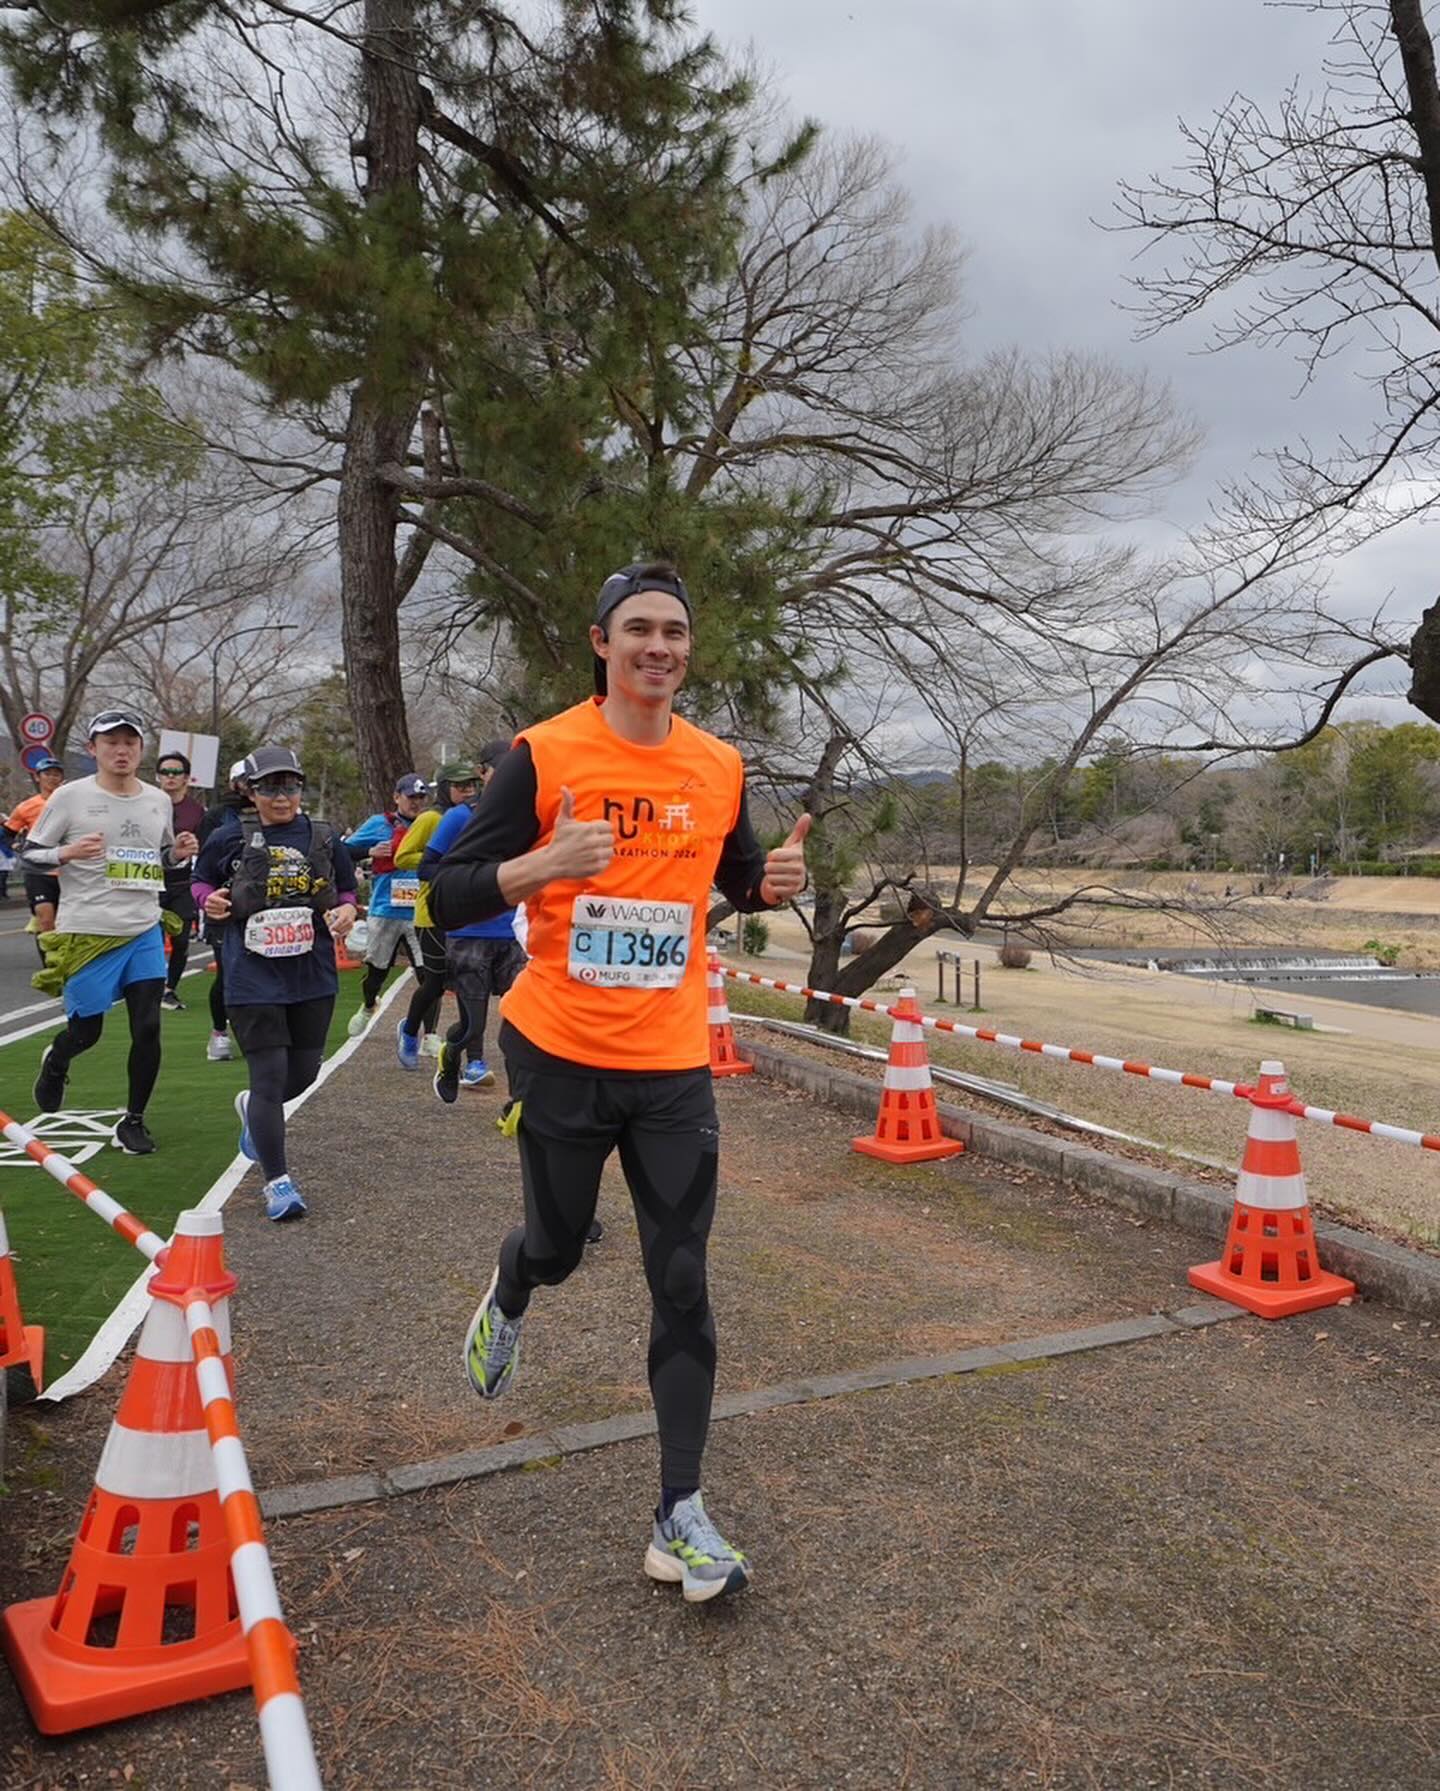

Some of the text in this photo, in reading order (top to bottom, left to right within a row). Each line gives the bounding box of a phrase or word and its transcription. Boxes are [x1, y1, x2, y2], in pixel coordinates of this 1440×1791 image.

[28, 721, 46, 733] 40
[603, 797, 654, 839] run
[612, 847, 669, 858] ARATHON
[611, 905, 684, 924] WACOAL
[575, 931, 685, 966] C 13966
[598, 971, 631, 982] MUFG
